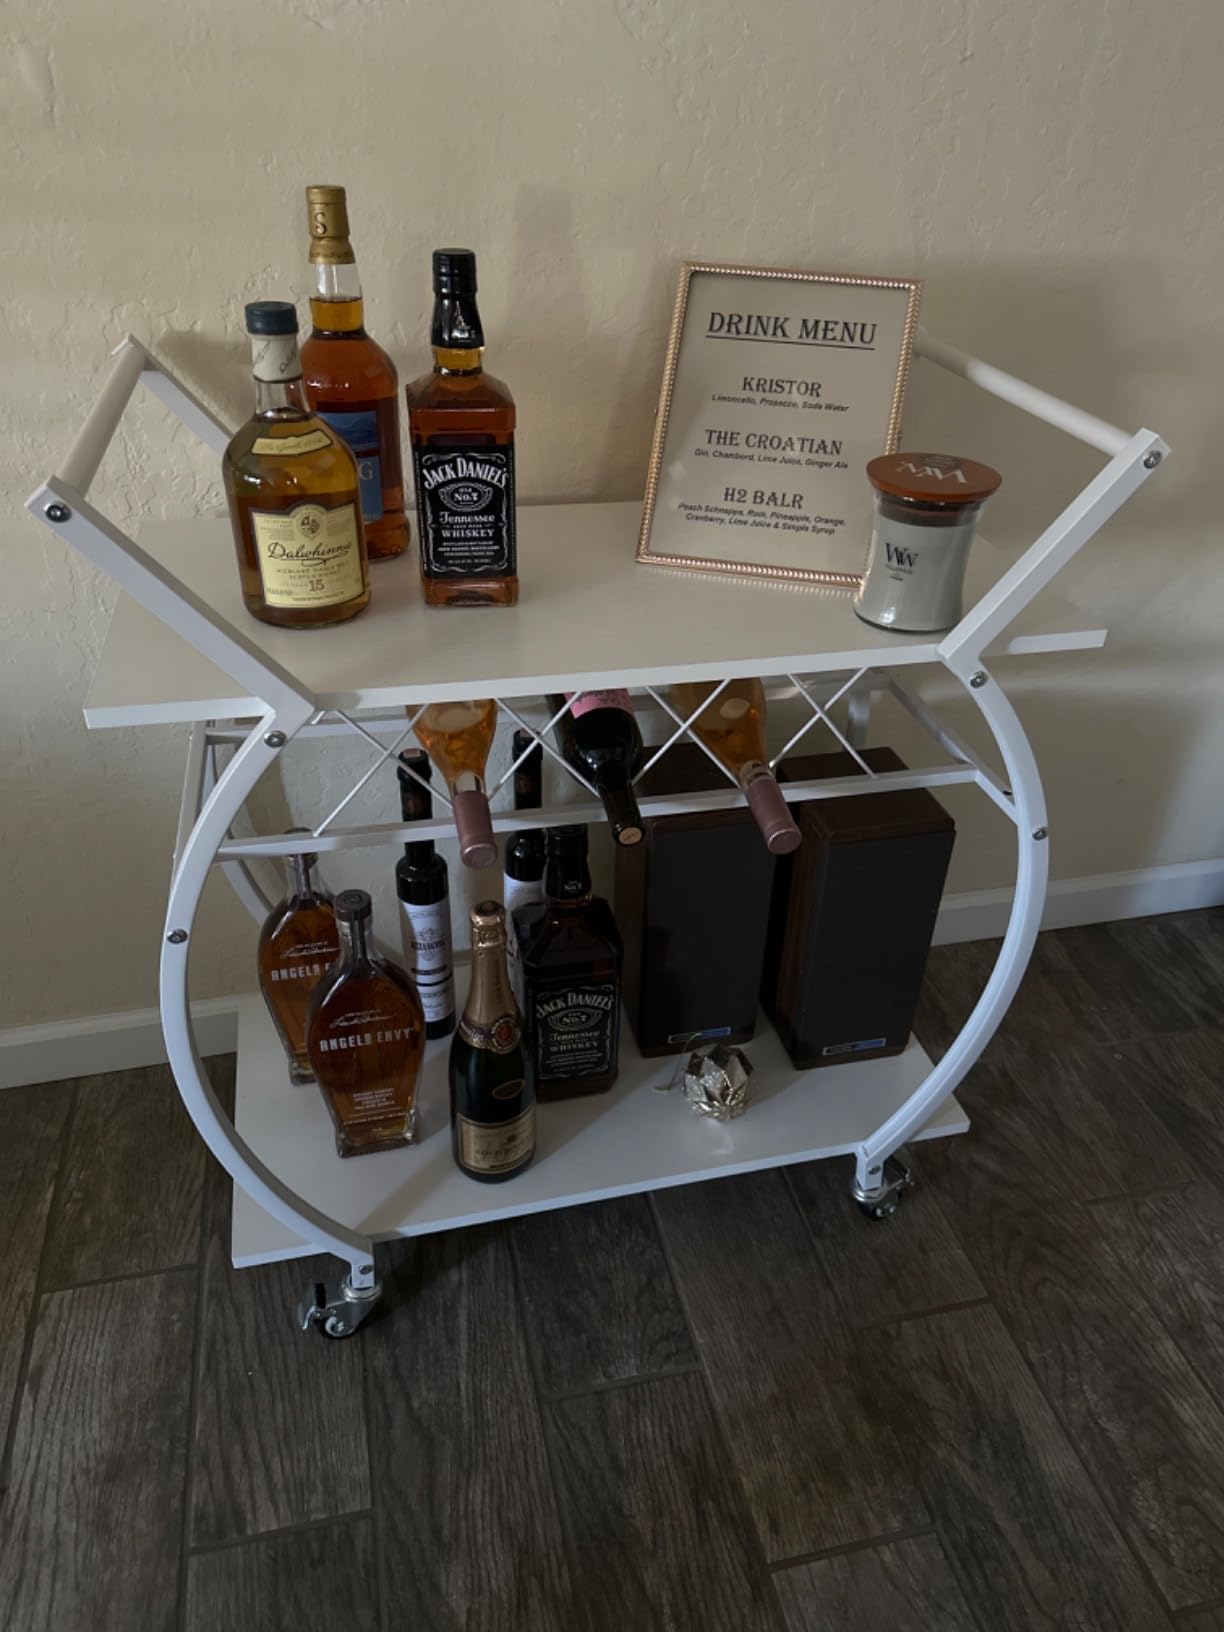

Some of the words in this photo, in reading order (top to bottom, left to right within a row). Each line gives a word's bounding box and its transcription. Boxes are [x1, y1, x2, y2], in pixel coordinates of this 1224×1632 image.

[708, 312, 790, 339] DRINK
[797, 318, 877, 344] MENU
[742, 376, 822, 398] KRISTOR
[801, 401, 822, 410] Soda
[825, 402, 850, 412] Water
[705, 429, 740, 446] THE
[745, 433, 842, 456] CROATIAN
[805, 458, 833, 468] Ginger
[422, 463, 457, 489] JACK
[457, 457, 509, 489] DANIEL'S
[724, 487, 748, 503] H2
[752, 490, 804, 509] BALR
[679, 502, 702, 511] Peach
[439, 511, 495, 524] Tennessee
[441, 529, 495, 538] WHISKEY
[750, 519, 771, 528] Juice
[773, 521, 780, 529] &
[782, 522, 809, 532] Simple
[811, 525, 835, 535] Syrup
[308, 579, 325, 592] 15
[536, 998, 567, 1020] JACK
[377, 1028, 411, 1042] ENVY
